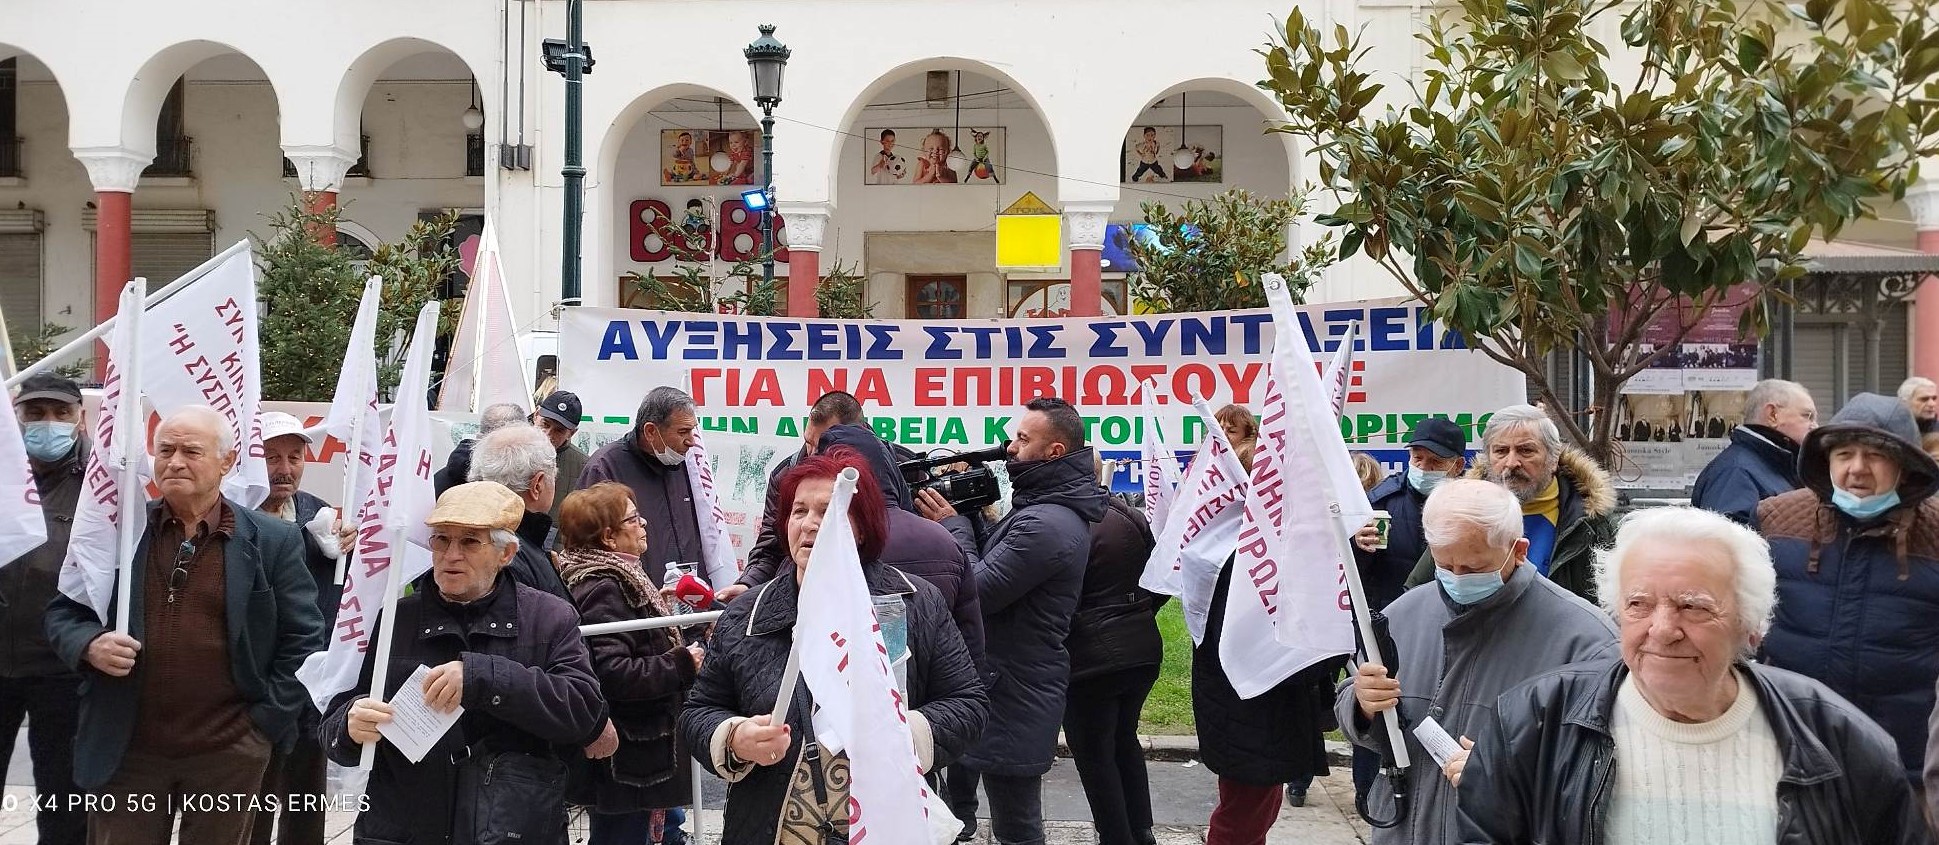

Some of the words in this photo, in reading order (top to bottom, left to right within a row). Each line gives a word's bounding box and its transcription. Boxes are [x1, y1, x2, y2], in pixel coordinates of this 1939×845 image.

[597, 320, 904, 361] ΑΥΞΗΣΕΙΣ
[922, 324, 1067, 360] ΣΤΙΣ
[690, 368, 786, 407] ΓΙΑ
[806, 368, 893, 407] ΝΑ
